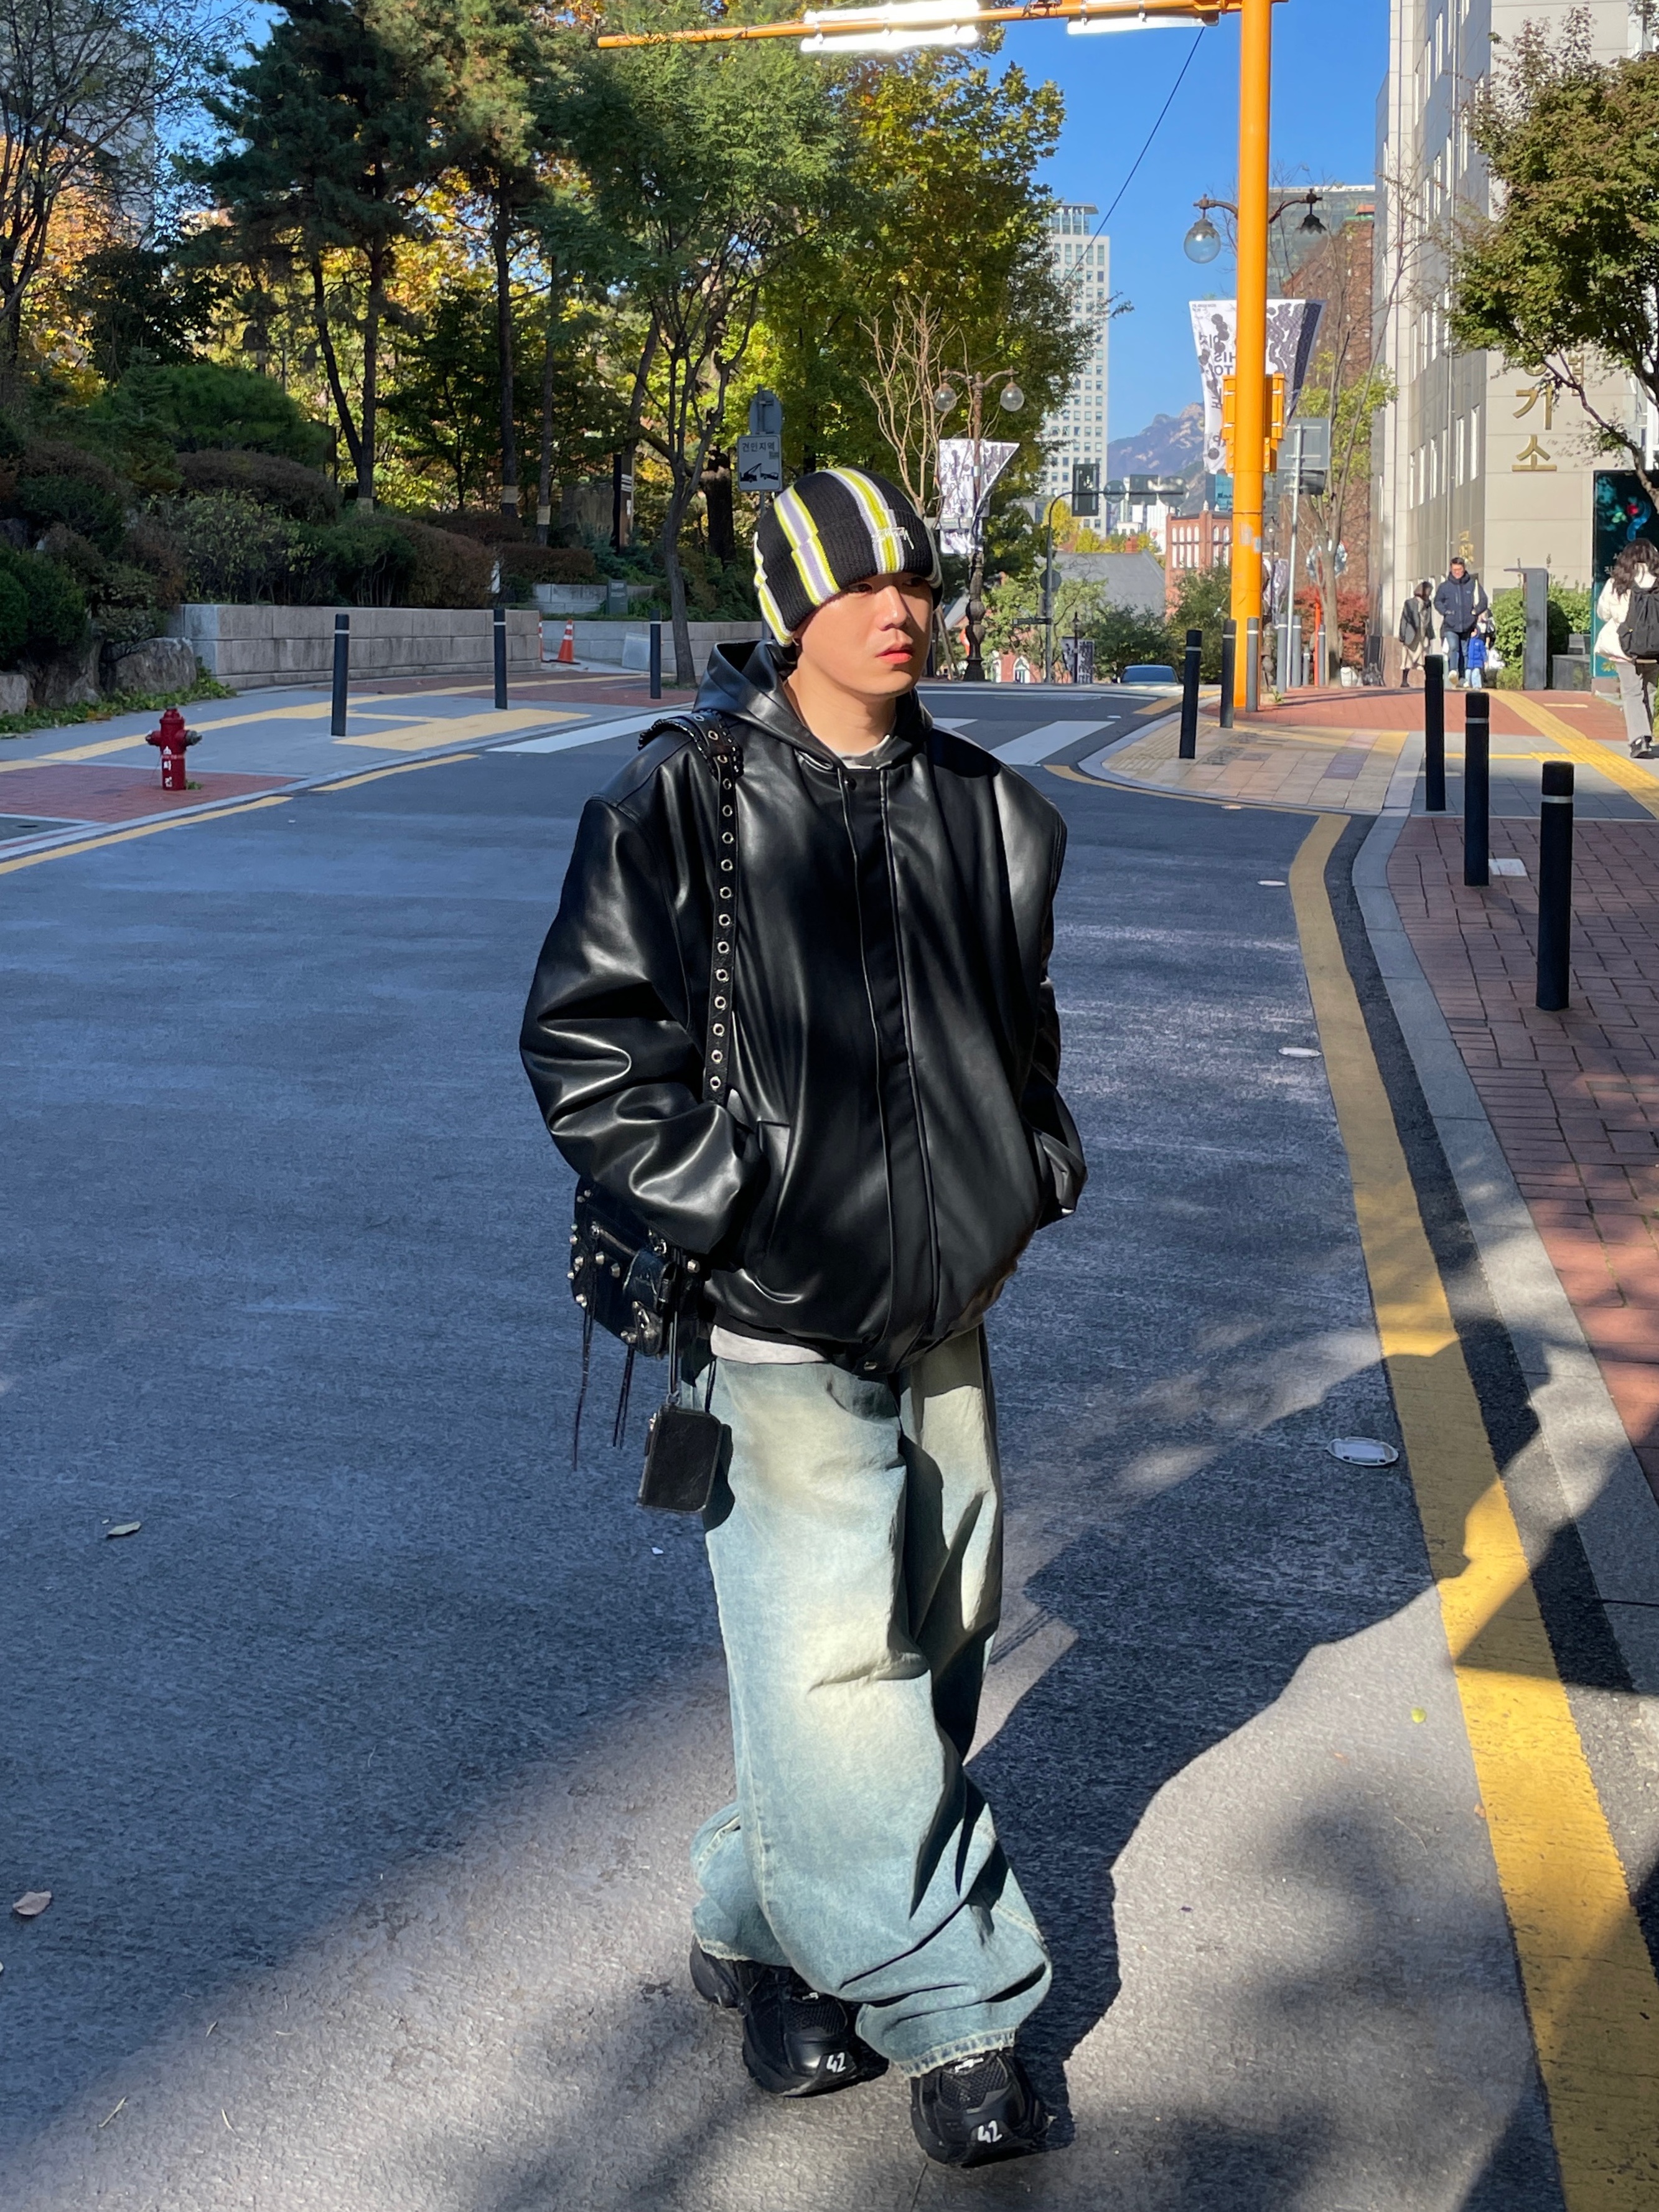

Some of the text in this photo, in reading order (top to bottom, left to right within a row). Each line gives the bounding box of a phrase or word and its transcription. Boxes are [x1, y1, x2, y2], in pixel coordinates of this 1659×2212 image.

[742, 441, 775, 452] 견인지역
[826, 2052, 846, 2073] 42
[978, 2120, 1002, 2143] 42
